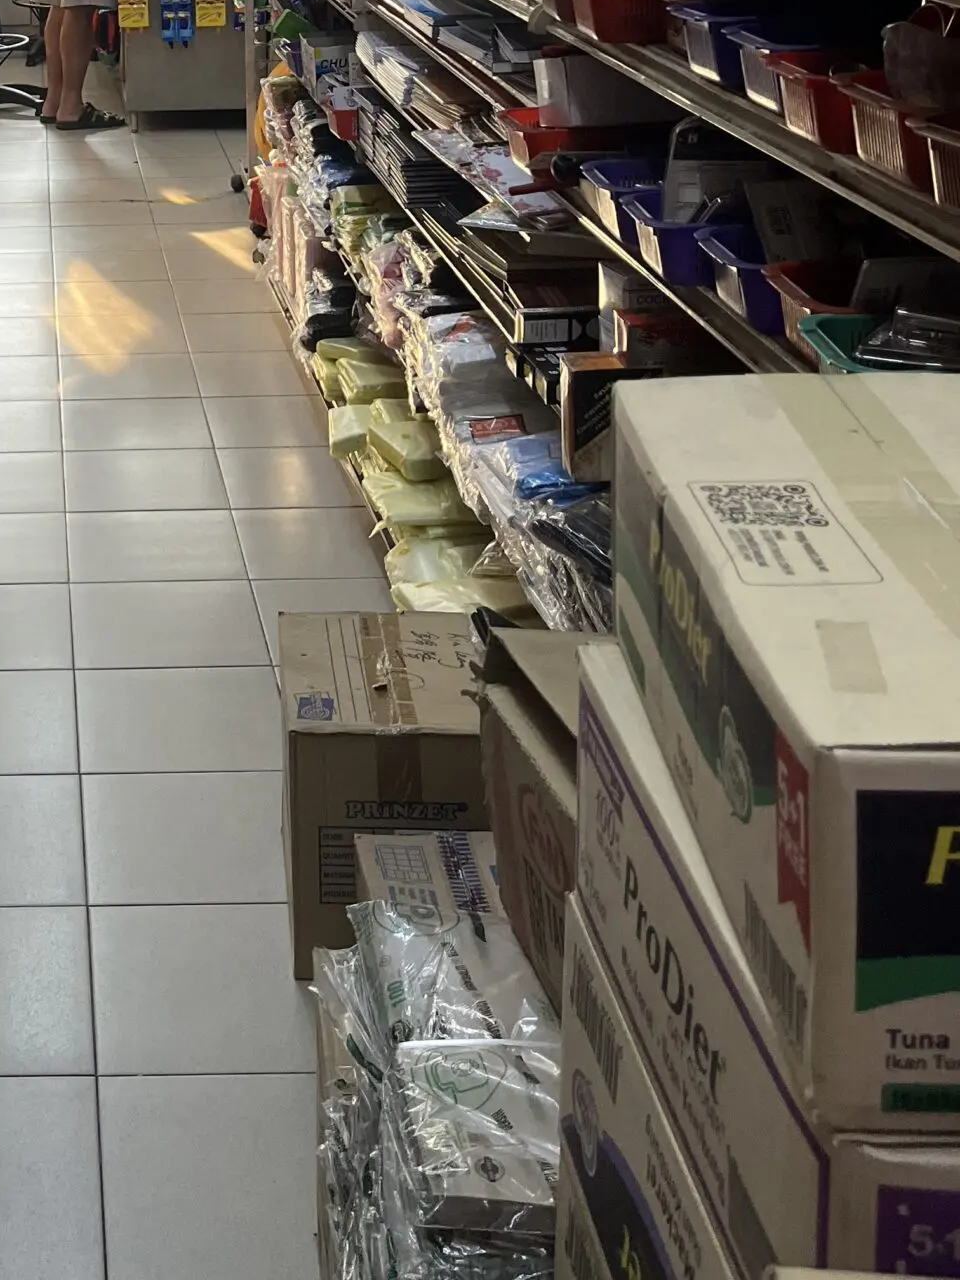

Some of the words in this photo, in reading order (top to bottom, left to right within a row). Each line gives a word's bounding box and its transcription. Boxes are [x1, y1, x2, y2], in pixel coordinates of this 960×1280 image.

[320, 58, 347, 70] CHU
[345, 800, 461, 820] PRINZET
[623, 854, 720, 1106] ProDiet
[885, 1028, 951, 1051] Tuna
[885, 1054, 928, 1070] Ikan
